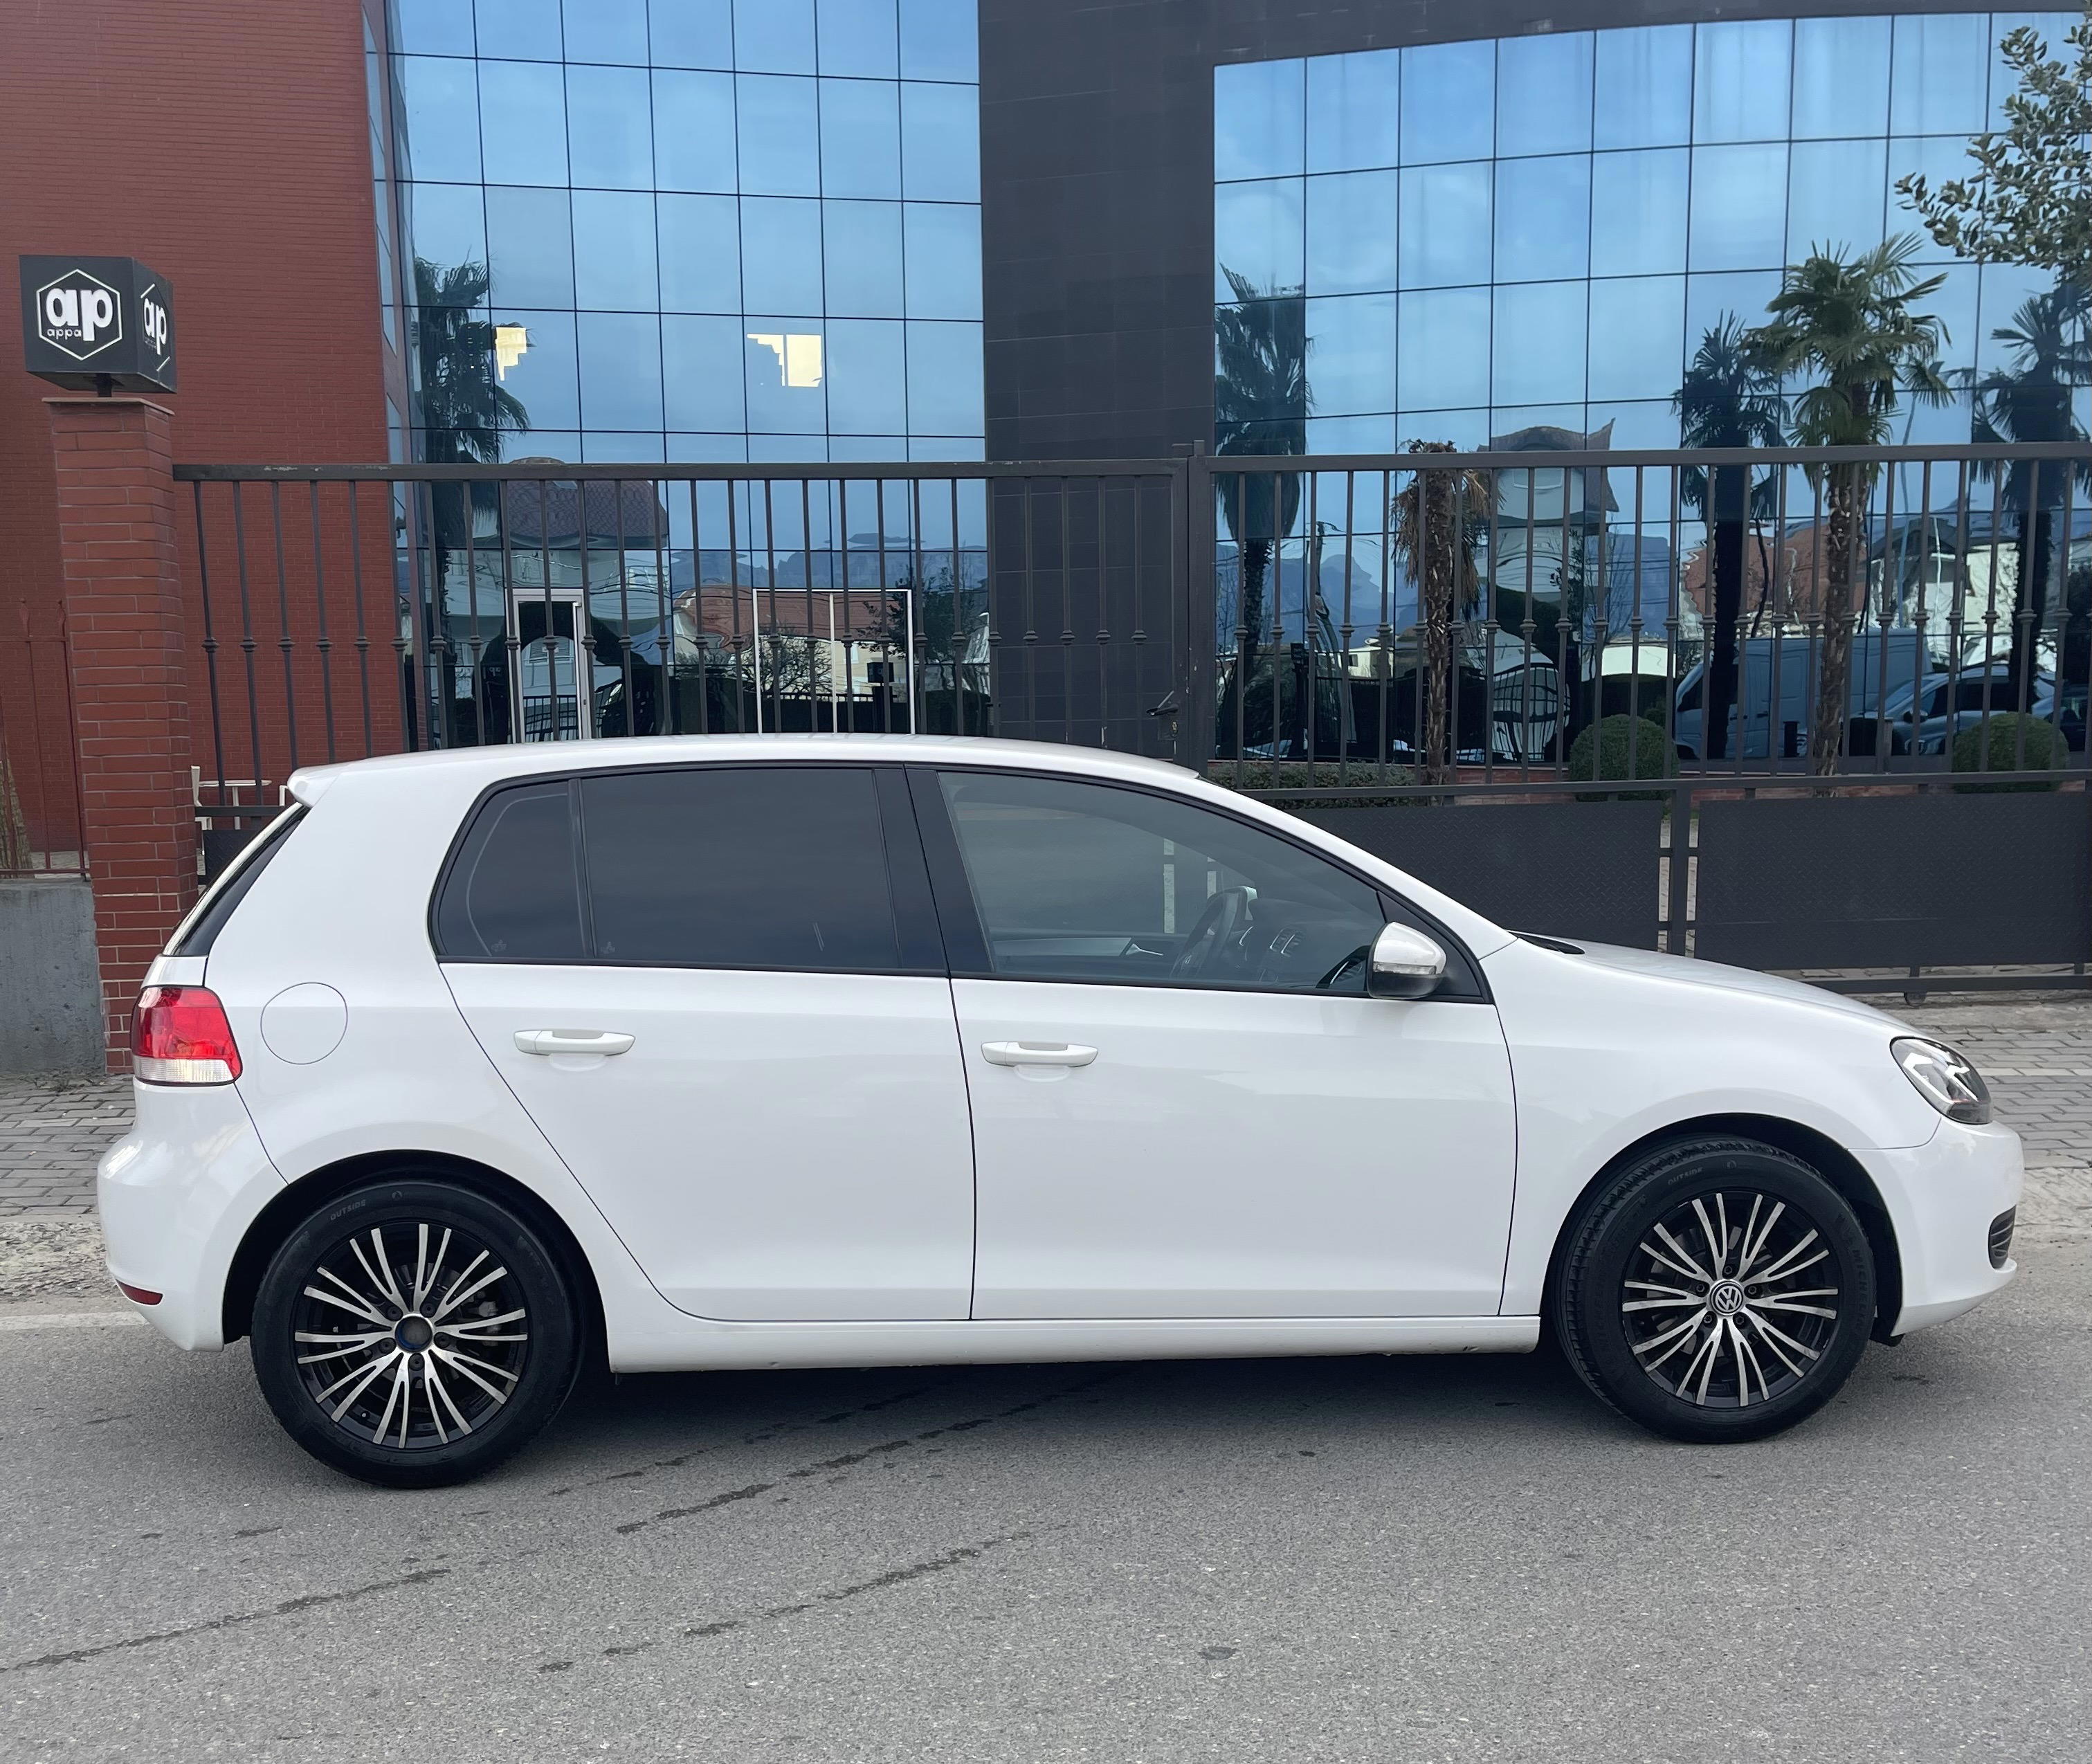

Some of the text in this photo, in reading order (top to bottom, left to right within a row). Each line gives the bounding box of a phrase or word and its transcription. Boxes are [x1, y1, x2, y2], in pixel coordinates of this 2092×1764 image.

[46, 288, 113, 341] ap
[143, 298, 167, 355] ap
[46, 328, 82, 340] appa
[330, 1199, 366, 1221] OUTSIDE
[1713, 1284, 1743, 1313] VW
